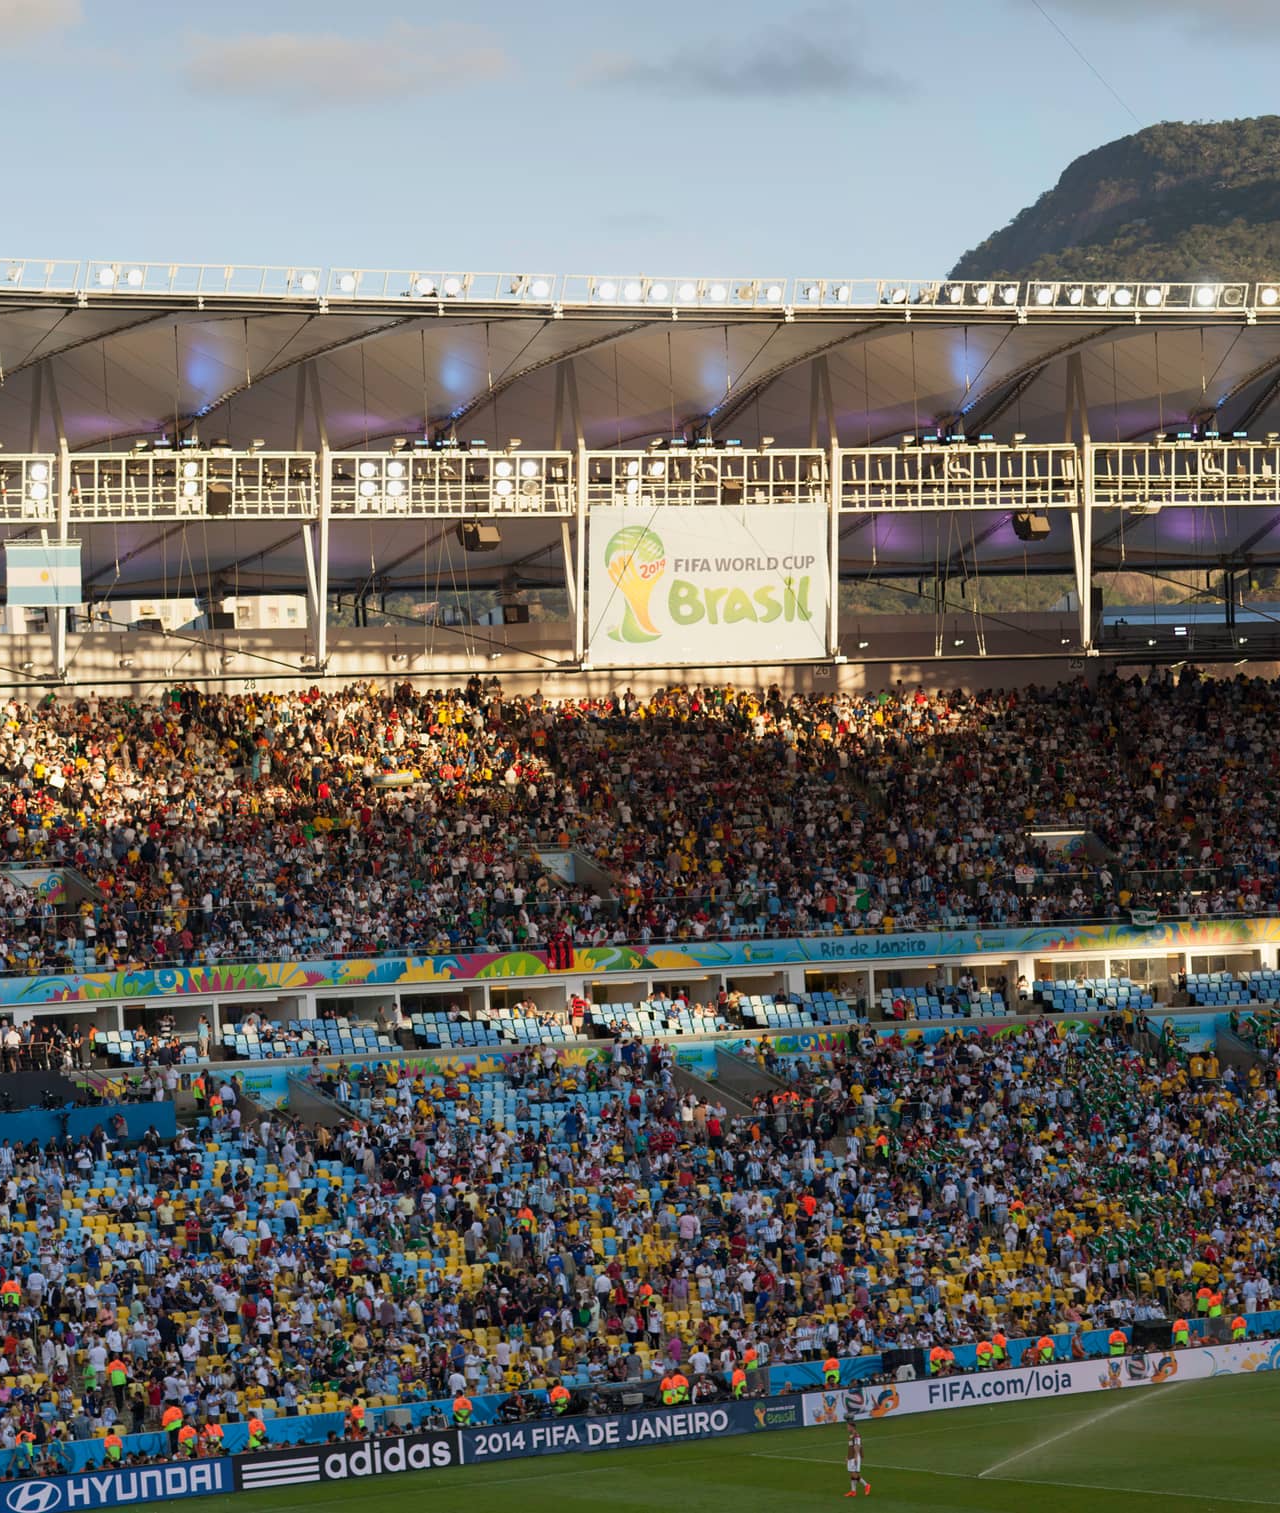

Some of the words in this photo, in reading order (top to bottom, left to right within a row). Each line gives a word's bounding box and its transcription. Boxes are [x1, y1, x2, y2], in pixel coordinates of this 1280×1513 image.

[639, 558, 667, 579] 2014
[673, 557, 711, 573] FIFA
[715, 556, 779, 572] WORLD
[782, 555, 816, 570] CUP
[668, 575, 813, 625] Brasil
[816, 665, 828, 676] 26
[1071, 659, 1082, 670] 25
[244, 679, 256, 690] 28
[821, 941, 845, 958] Rio
[850, 940, 868, 955] de
[873, 937, 927, 956] Janeiro
[928, 1370, 1073, 1404] FIFA.com/loja
[474, 1431, 526, 1456] 2014
[532, 1425, 582, 1448] FIFA
[587, 1421, 620, 1446] DE
[625, 1410, 729, 1443] JANEIRO
[324, 1436, 453, 1477] adidas
[66, 1462, 223, 1507] HYUNDAI
